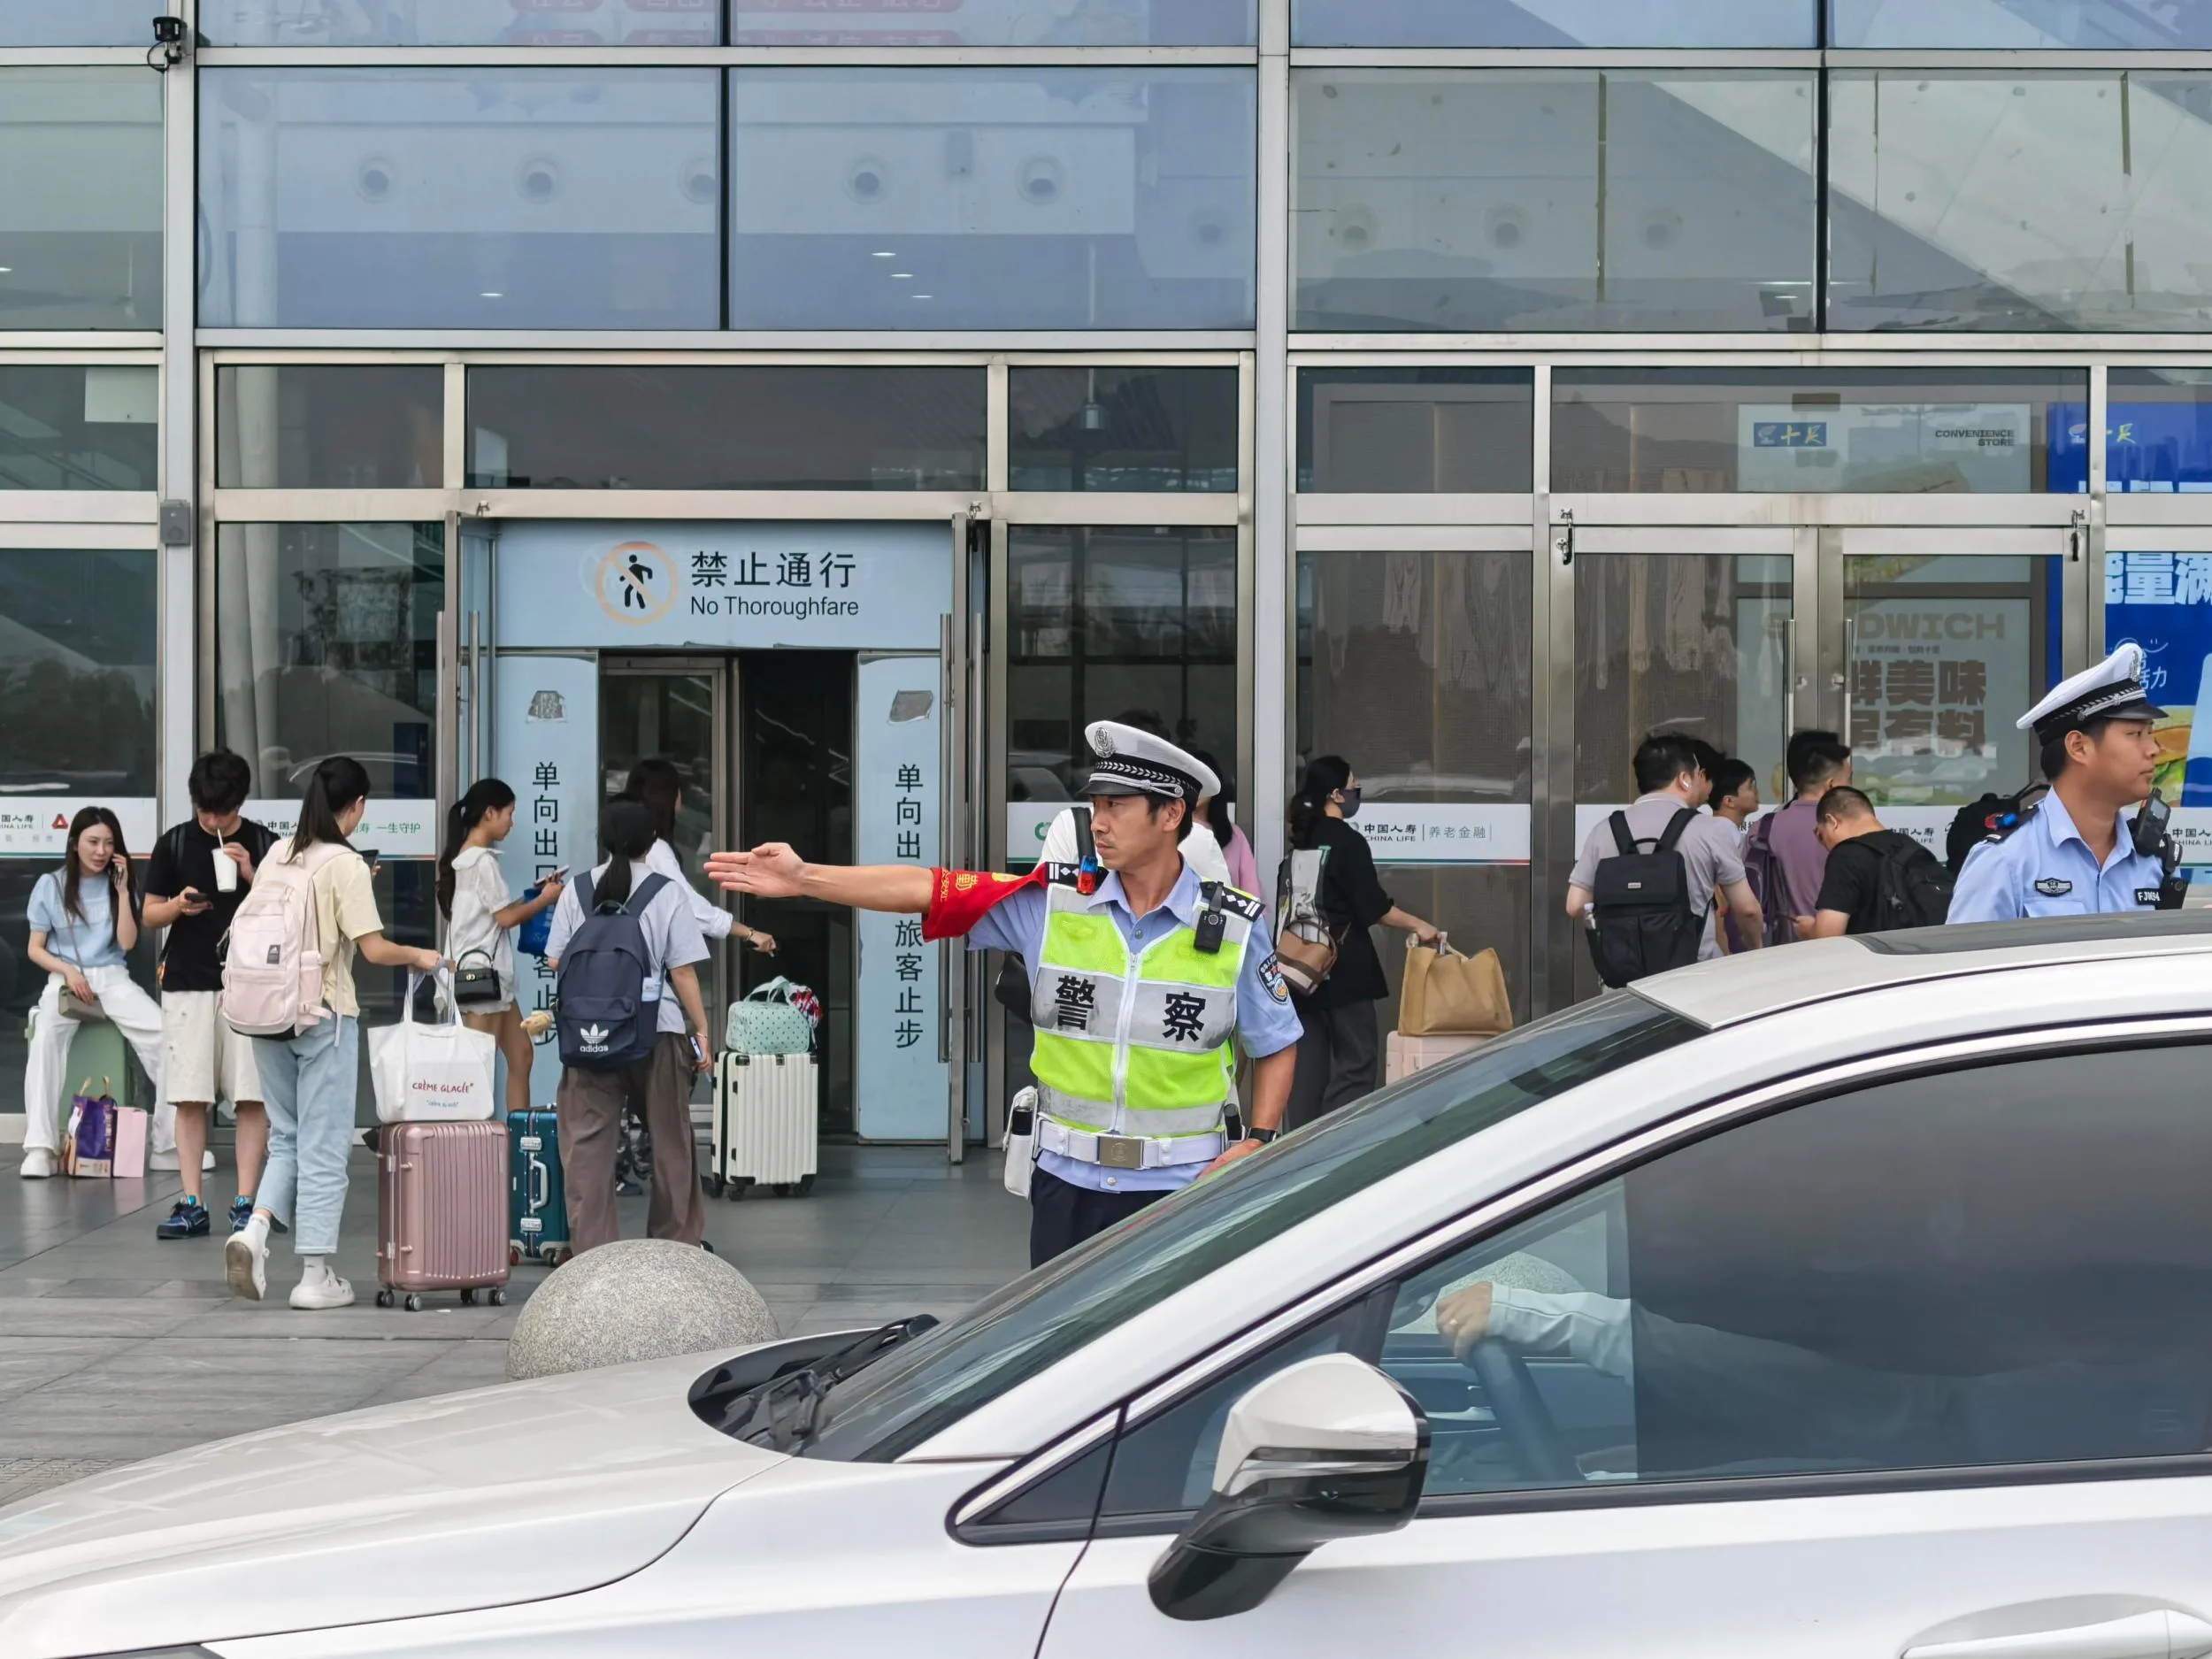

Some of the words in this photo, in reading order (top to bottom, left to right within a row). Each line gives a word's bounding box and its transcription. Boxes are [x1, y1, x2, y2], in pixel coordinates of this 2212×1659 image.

[1935, 429, 2015, 438] CONVENIENCE
[1978, 438, 2015, 447] STORE
[691, 550, 856, 588] 禁止通行
[691, 596, 718, 616] No
[725, 596, 859, 619] Thoroughfare
[895, 764, 923, 859] 单向出
[376, 822, 421, 833] 一生守护
[1364, 823, 1417, 834] 中国人寿
[1429, 826, 1486, 839] 养老金融
[895, 920, 923, 1048] 旅客止步
